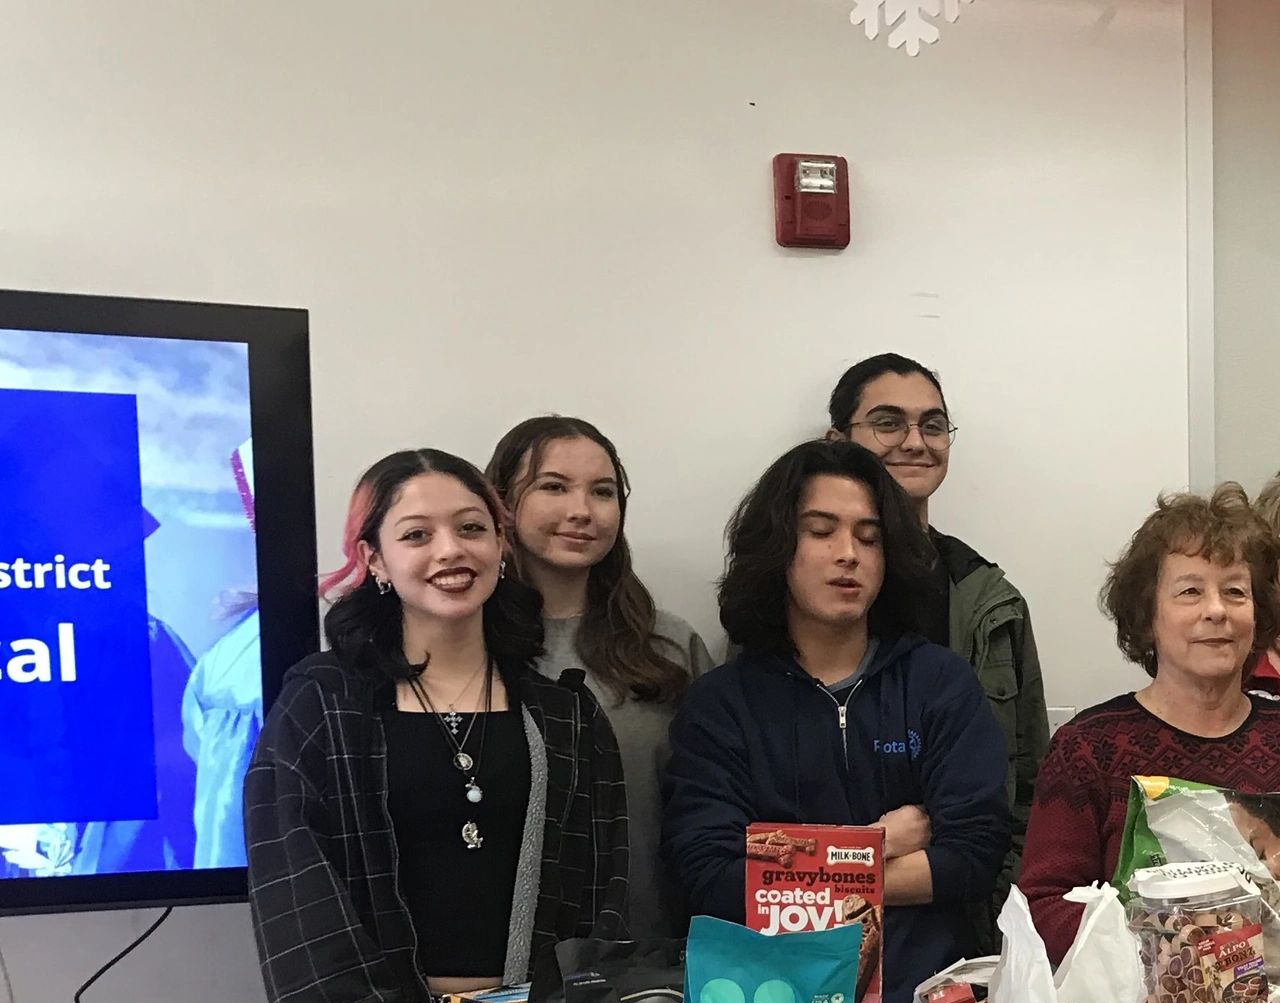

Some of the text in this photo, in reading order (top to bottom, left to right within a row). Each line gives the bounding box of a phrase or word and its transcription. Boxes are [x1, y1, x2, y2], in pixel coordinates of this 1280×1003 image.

[0, 622, 77, 683] al
[762, 867, 876, 886] gravybones
[755, 888, 831, 905] coated
[834, 884, 876, 894] biscuits
[757, 904, 769, 914] in
